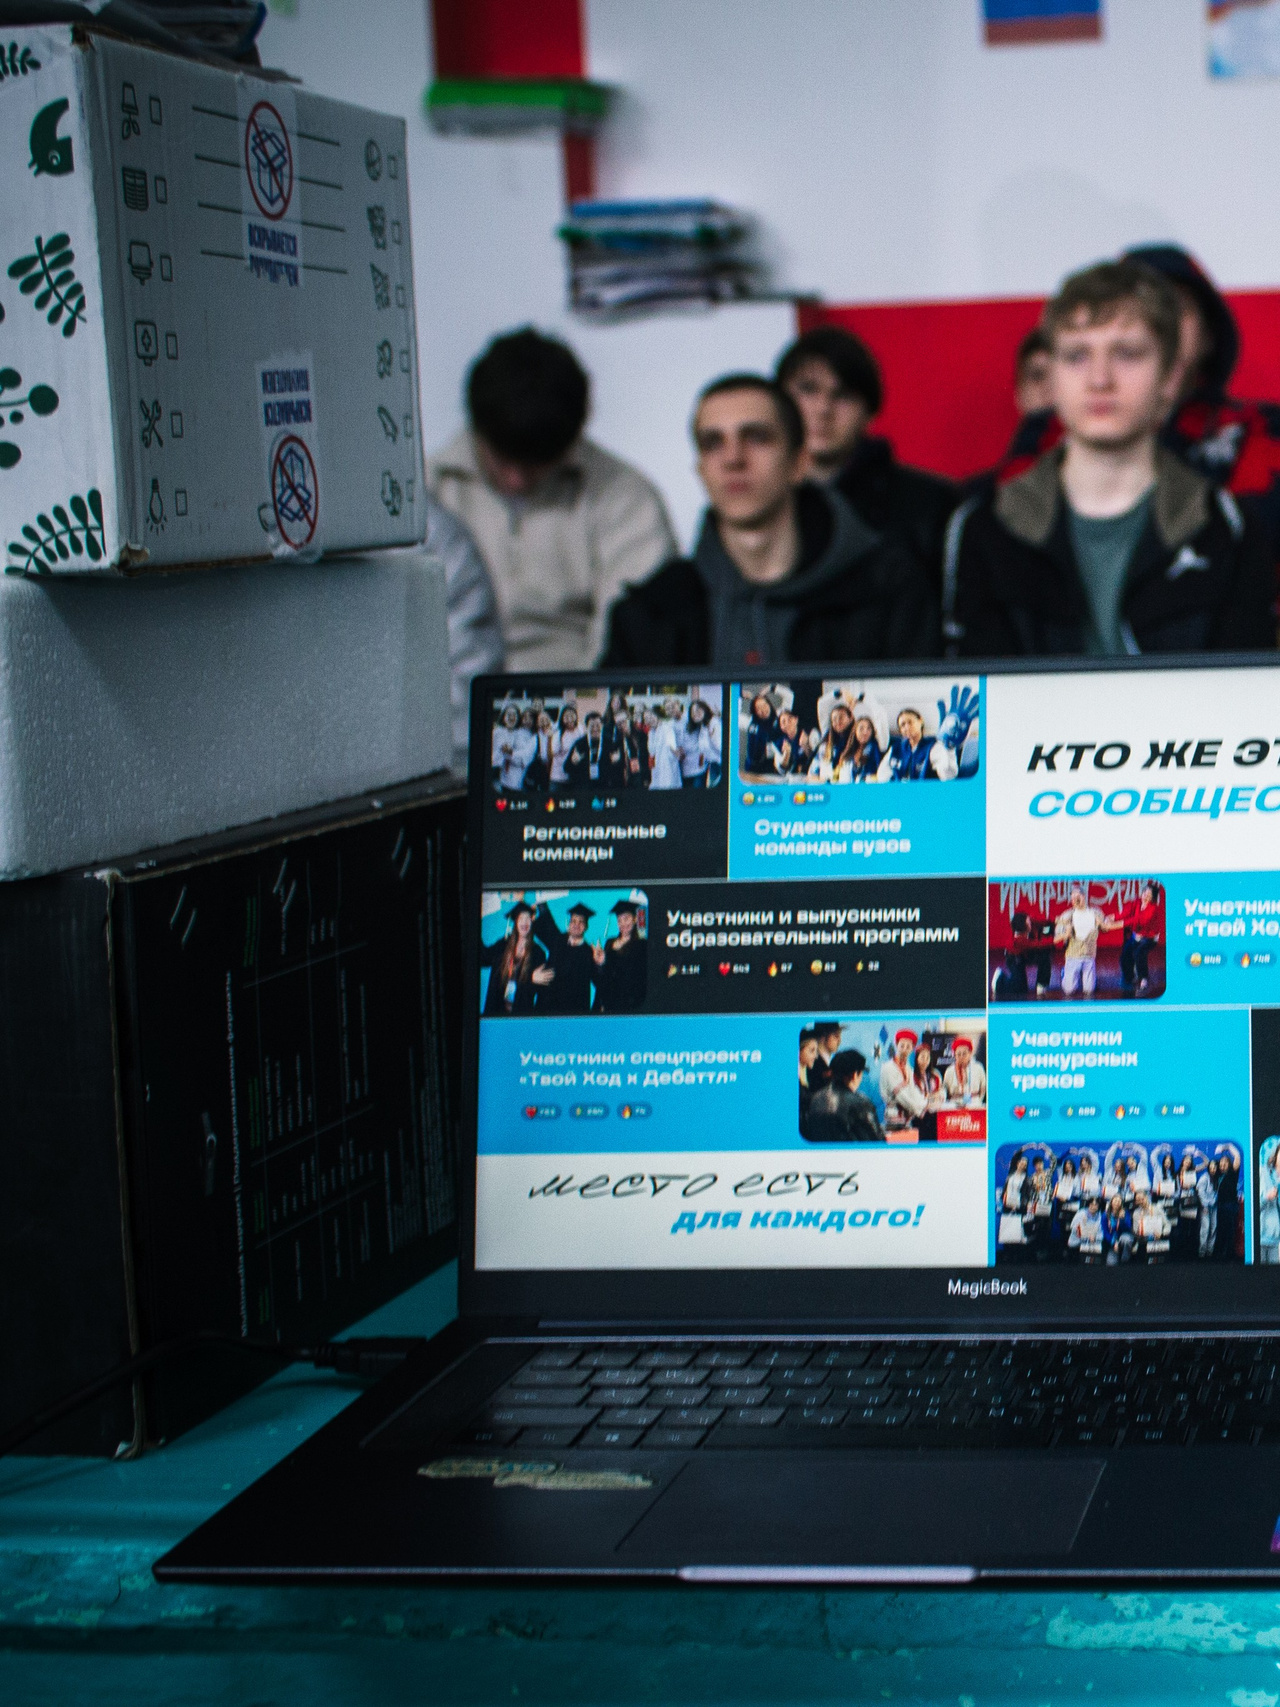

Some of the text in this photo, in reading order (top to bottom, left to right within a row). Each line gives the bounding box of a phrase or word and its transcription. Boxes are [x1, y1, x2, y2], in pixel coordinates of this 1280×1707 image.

[1028, 743, 1132, 771] КТО
[1142, 741, 1224, 769] ЖЕ
[524, 823, 666, 842] Региональные
[755, 818, 901, 837] Студенческие
[523, 845, 613, 862] команды
[755, 838, 911, 857] команды вузов
[666, 907, 920, 927] Участники и выпускники
[1185, 918, 1245, 937] «Твой
[666, 927, 959, 950] образовательных программ
[1012, 1030, 1122, 1048] Участники
[520, 1049, 762, 1066] Участники спецпроекта
[1012, 1051, 1138, 1069] конкурсных
[520, 1070, 577, 1087] «Твой
[582, 1071, 621, 1088] Ход
[643, 1069, 737, 1086] Дебаттл»
[1012, 1073, 1085, 1091] треков
[734, 1171, 860, 1197] есть
[671, 1205, 925, 1234] для каждого!
[947, 1279, 1028, 1299] MagicBook
